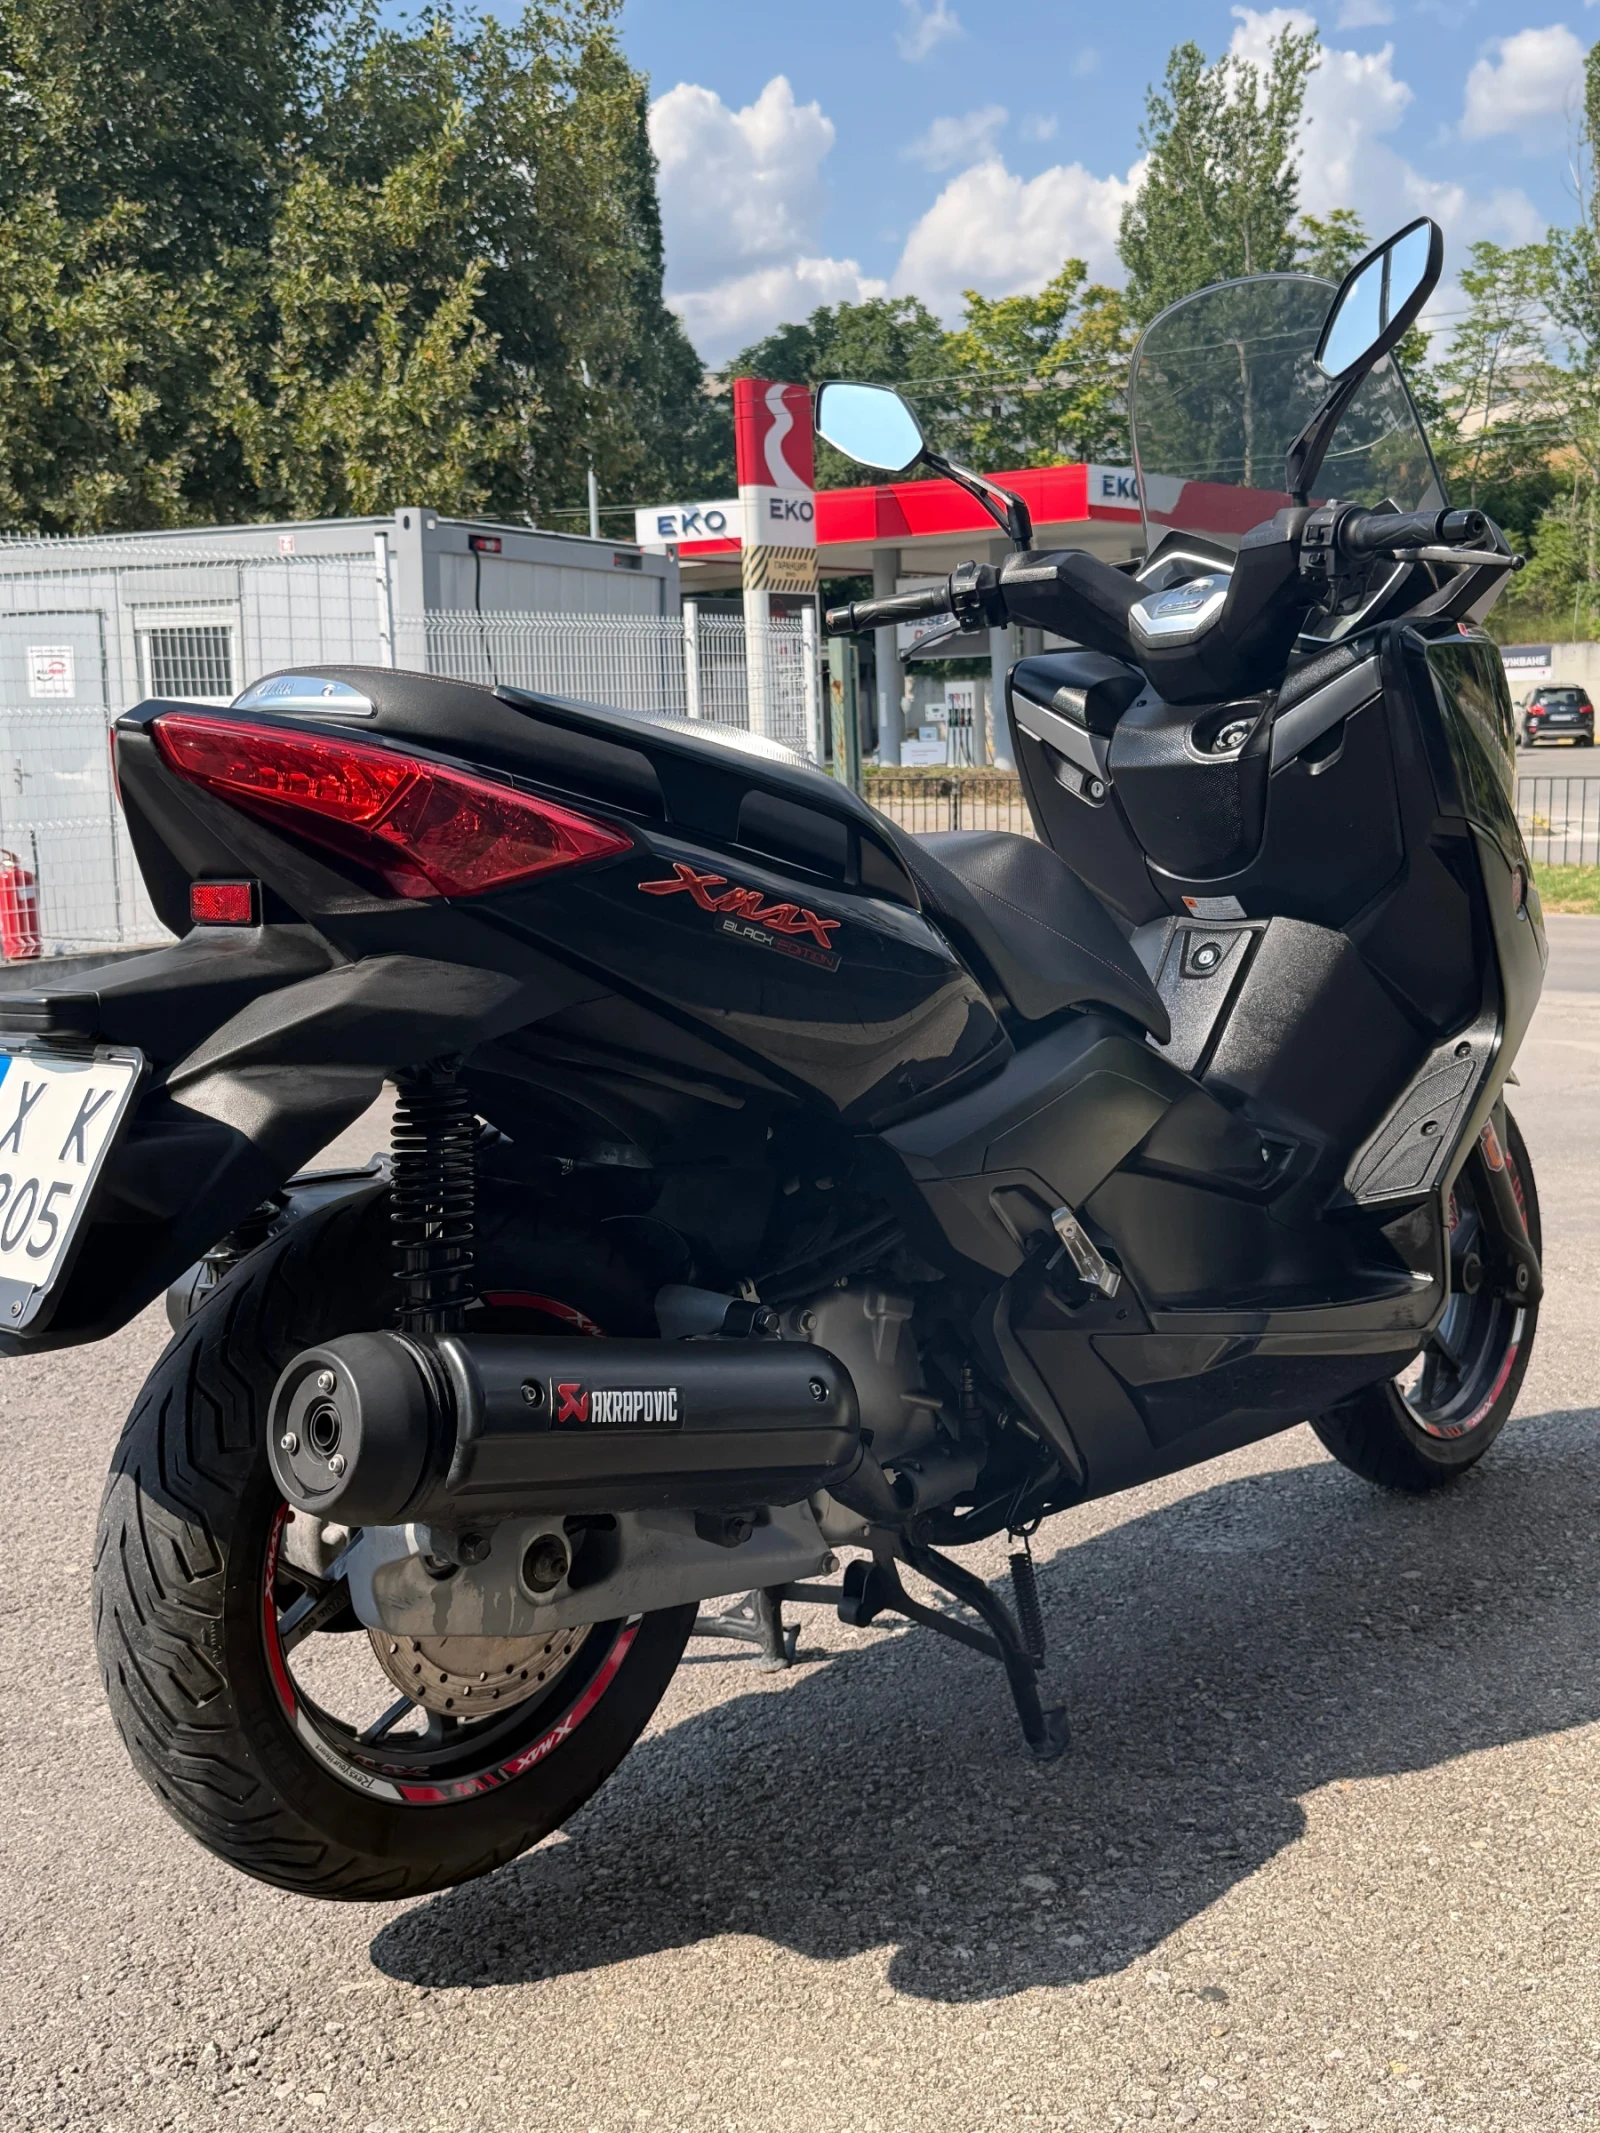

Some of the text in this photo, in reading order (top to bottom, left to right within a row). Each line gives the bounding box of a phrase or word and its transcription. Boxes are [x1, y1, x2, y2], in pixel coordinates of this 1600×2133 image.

[657, 510, 726, 536] EKO
[770, 498, 814, 522] EKO
[638, 862, 841, 949] XMAX
[722, 919, 834, 967] BLACK EDITION
[591, 1388, 678, 1422] AKRAPOVIČ
